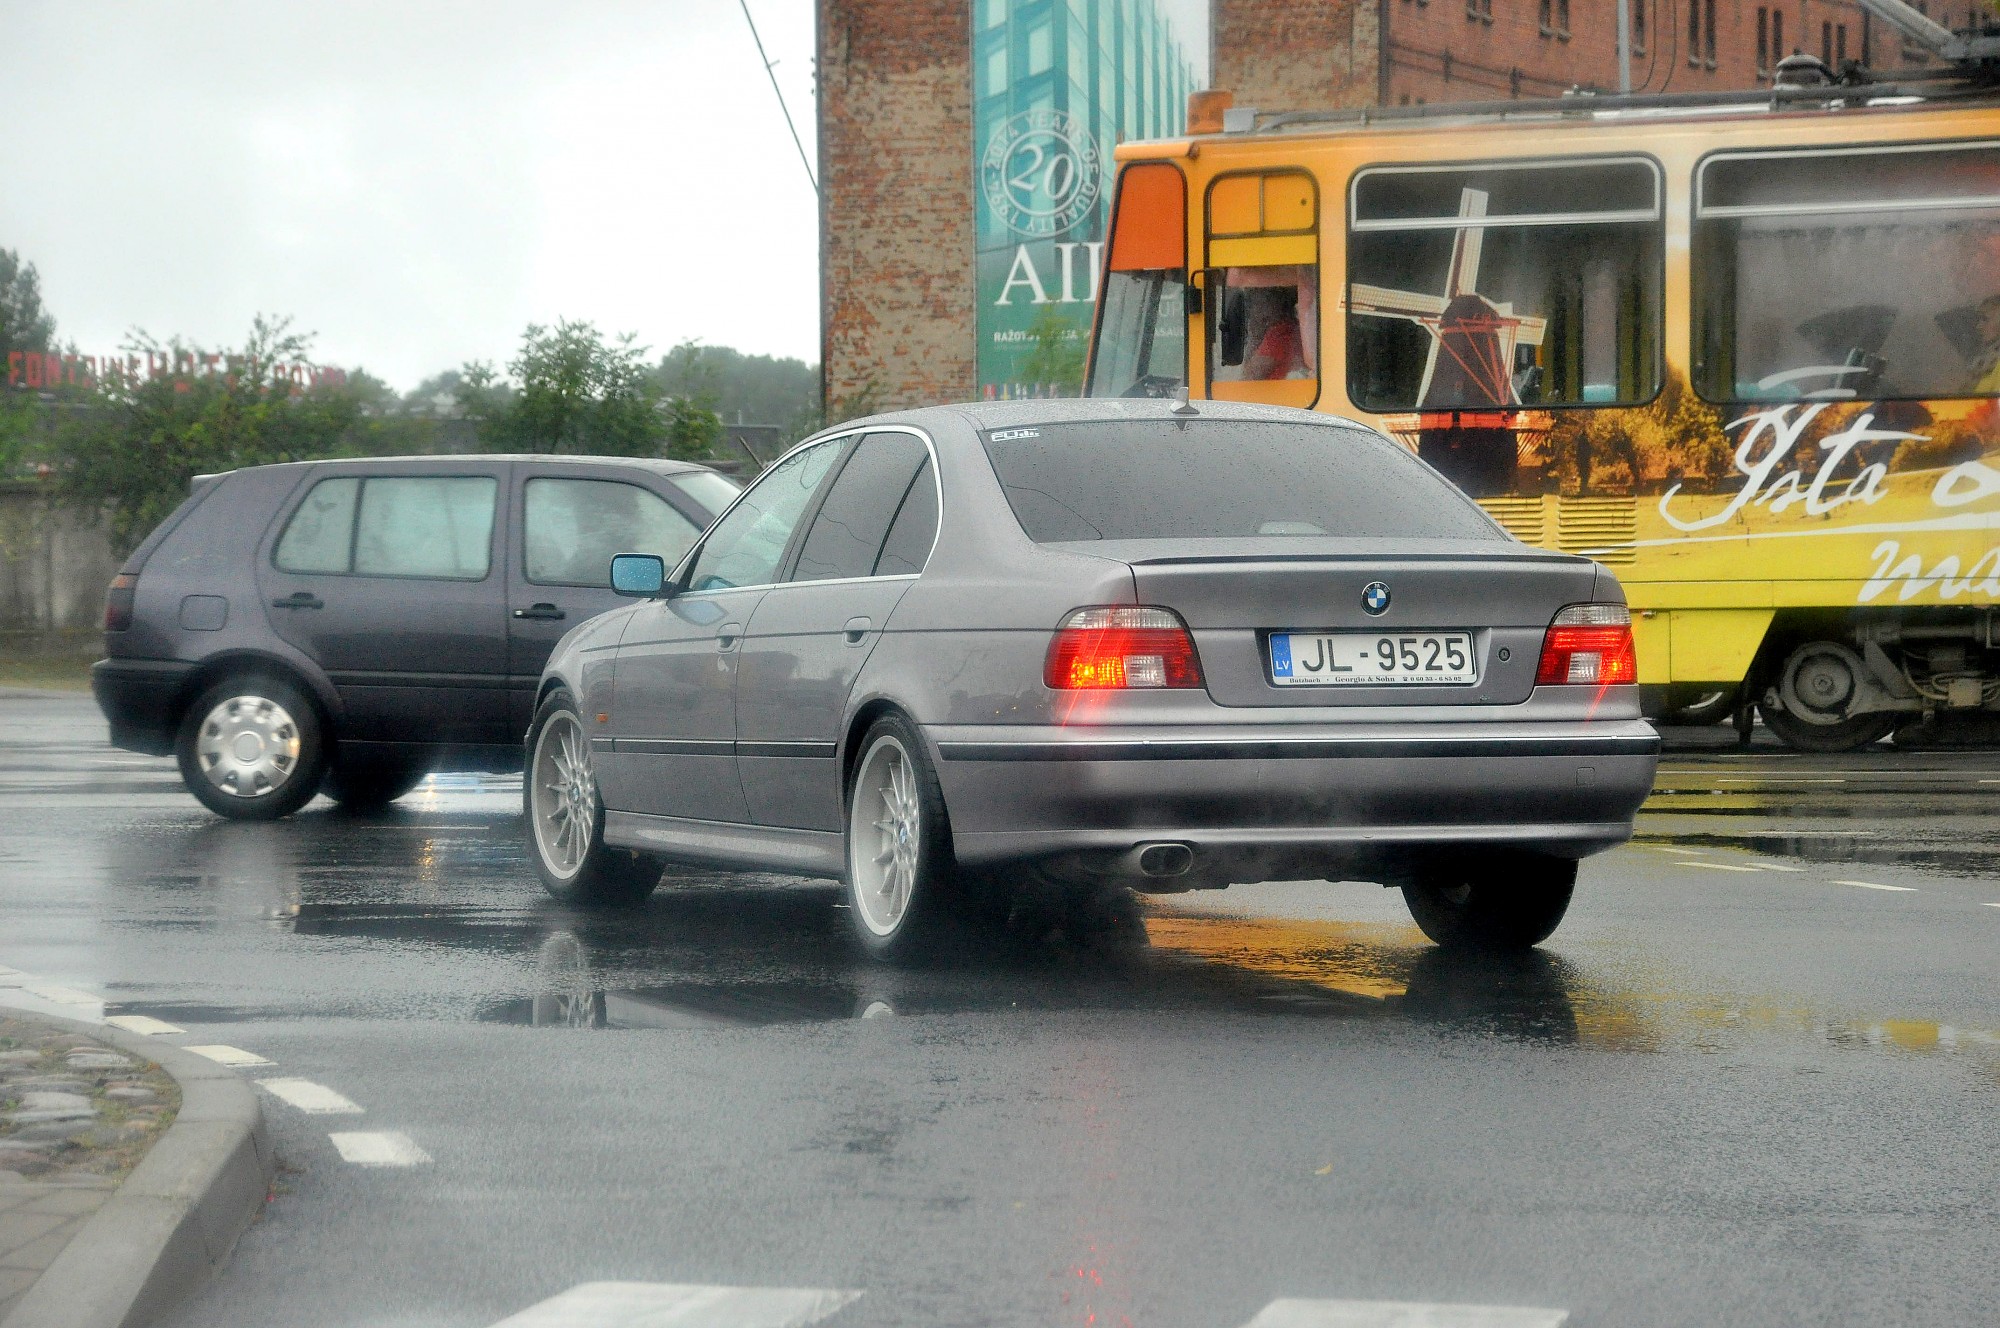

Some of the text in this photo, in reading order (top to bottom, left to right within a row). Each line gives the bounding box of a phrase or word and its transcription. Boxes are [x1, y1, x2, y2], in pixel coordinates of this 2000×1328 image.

[1008, 143, 1075, 201] 20
[1081, 148, 1099, 174] OF
[1026, 180, 1097, 232] QUALITY
[1275, 659, 1291, 671] LV
[1302, 637, 1466, 671] JL-9525
[1367, 675, 1374, 683] &
[1376, 675, 1395, 683] Sohn
